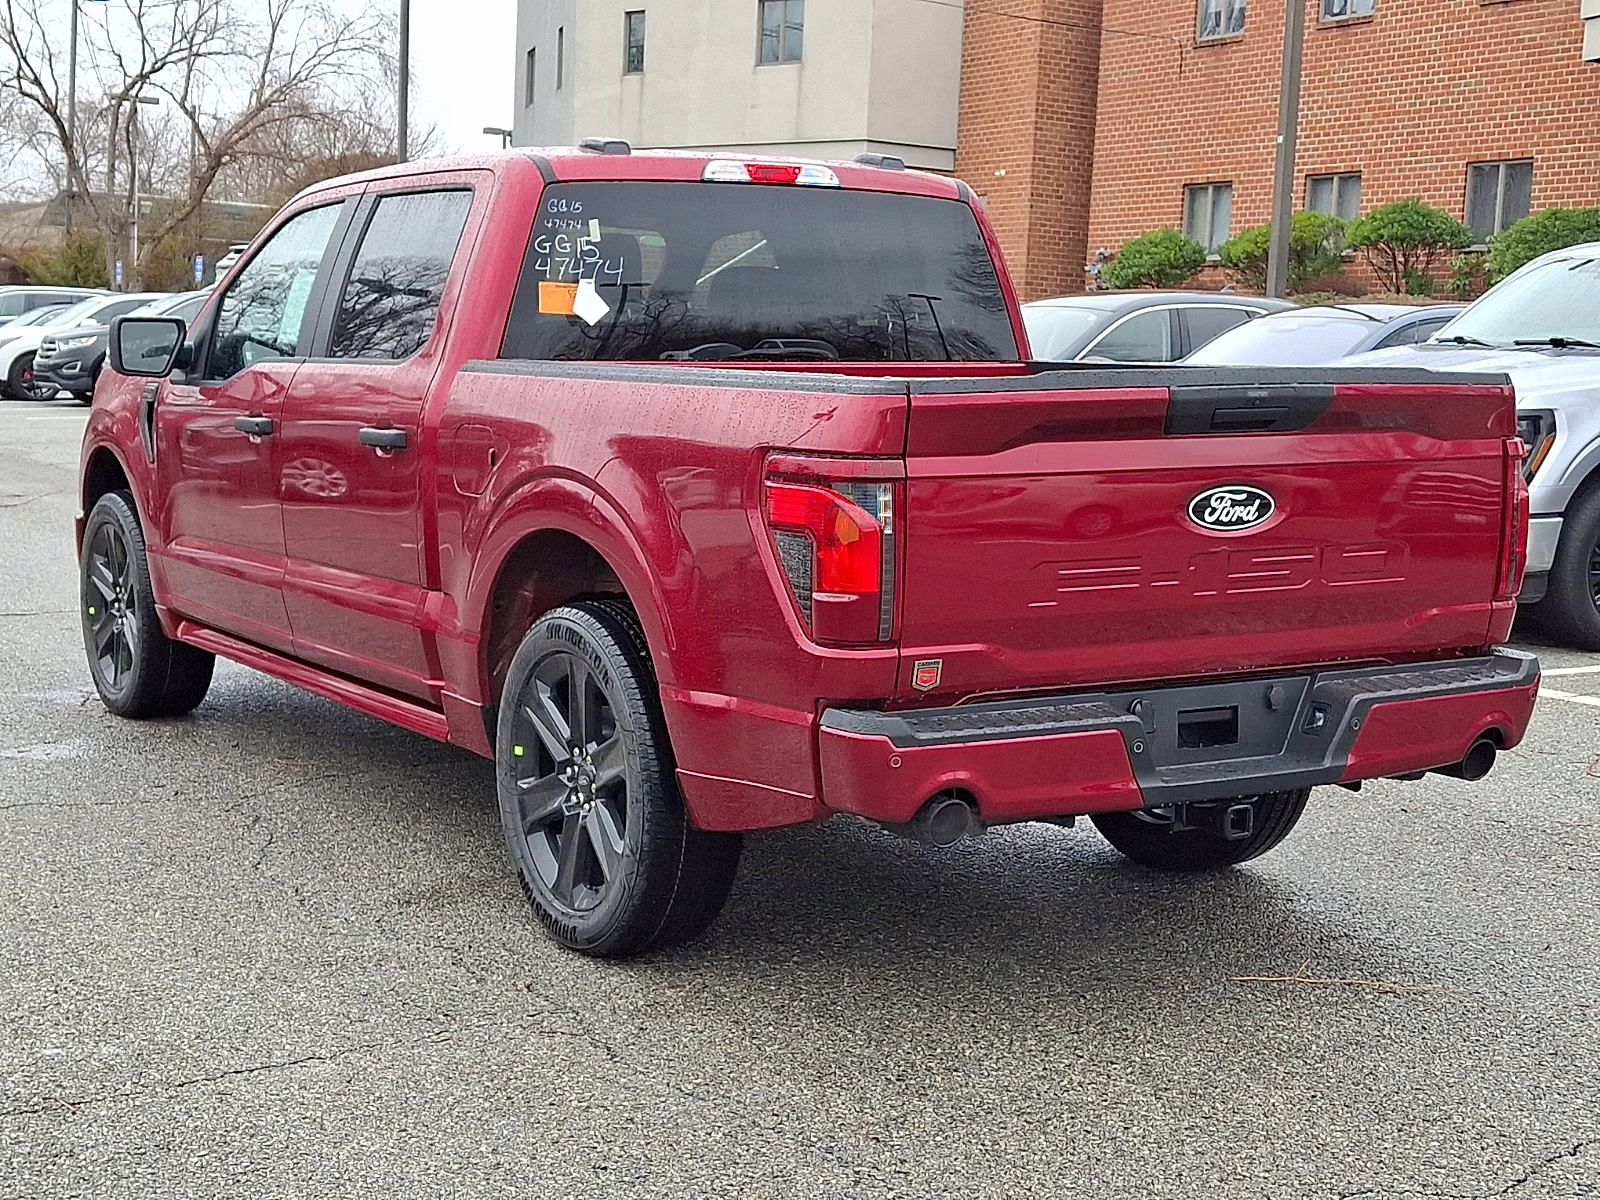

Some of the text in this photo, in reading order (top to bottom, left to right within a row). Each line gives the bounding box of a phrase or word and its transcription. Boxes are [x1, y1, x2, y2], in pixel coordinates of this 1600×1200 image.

[544, 219, 582, 230] 47474
[534, 256, 624, 286] 47474
[1203, 492, 1261, 523] Ford
[1028, 542, 1412, 607] F-150
